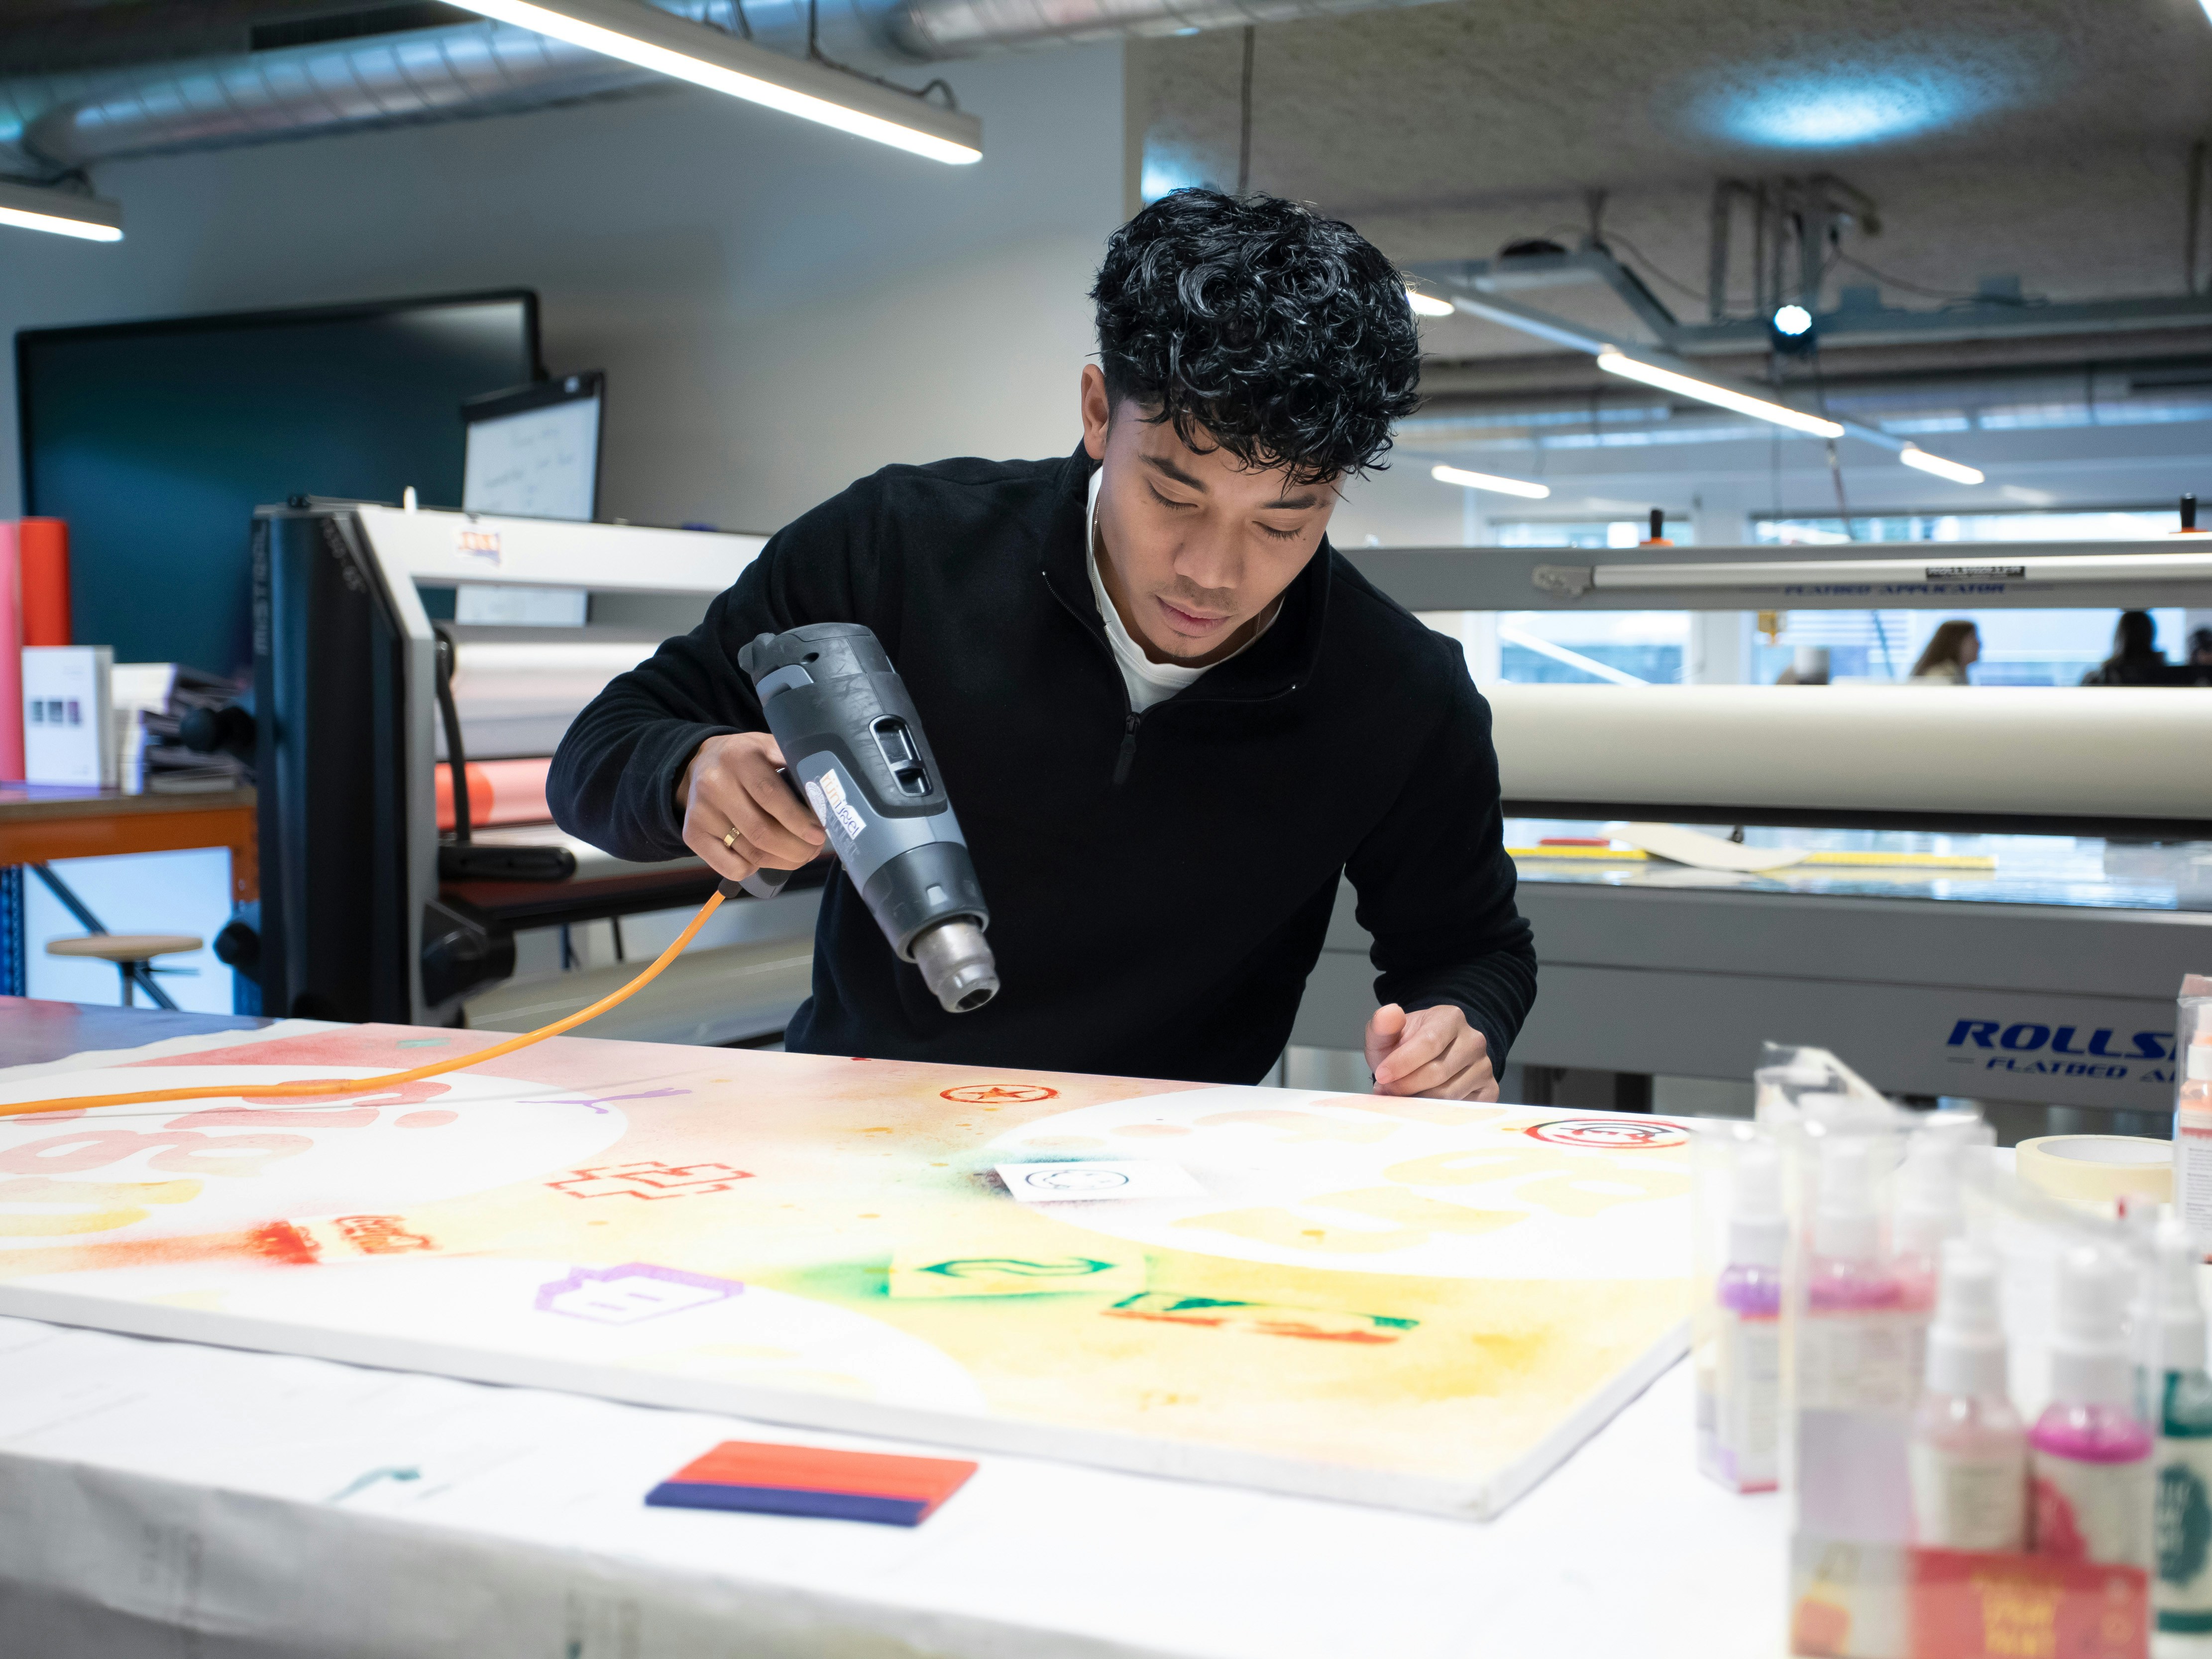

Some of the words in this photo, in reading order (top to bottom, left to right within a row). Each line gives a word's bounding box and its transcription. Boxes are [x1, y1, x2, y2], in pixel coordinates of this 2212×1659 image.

[1947, 1019, 2177, 1062] ROLLS
[1986, 1055, 2128, 1080] FLATBED
[2139, 1069, 2176, 1084] A
